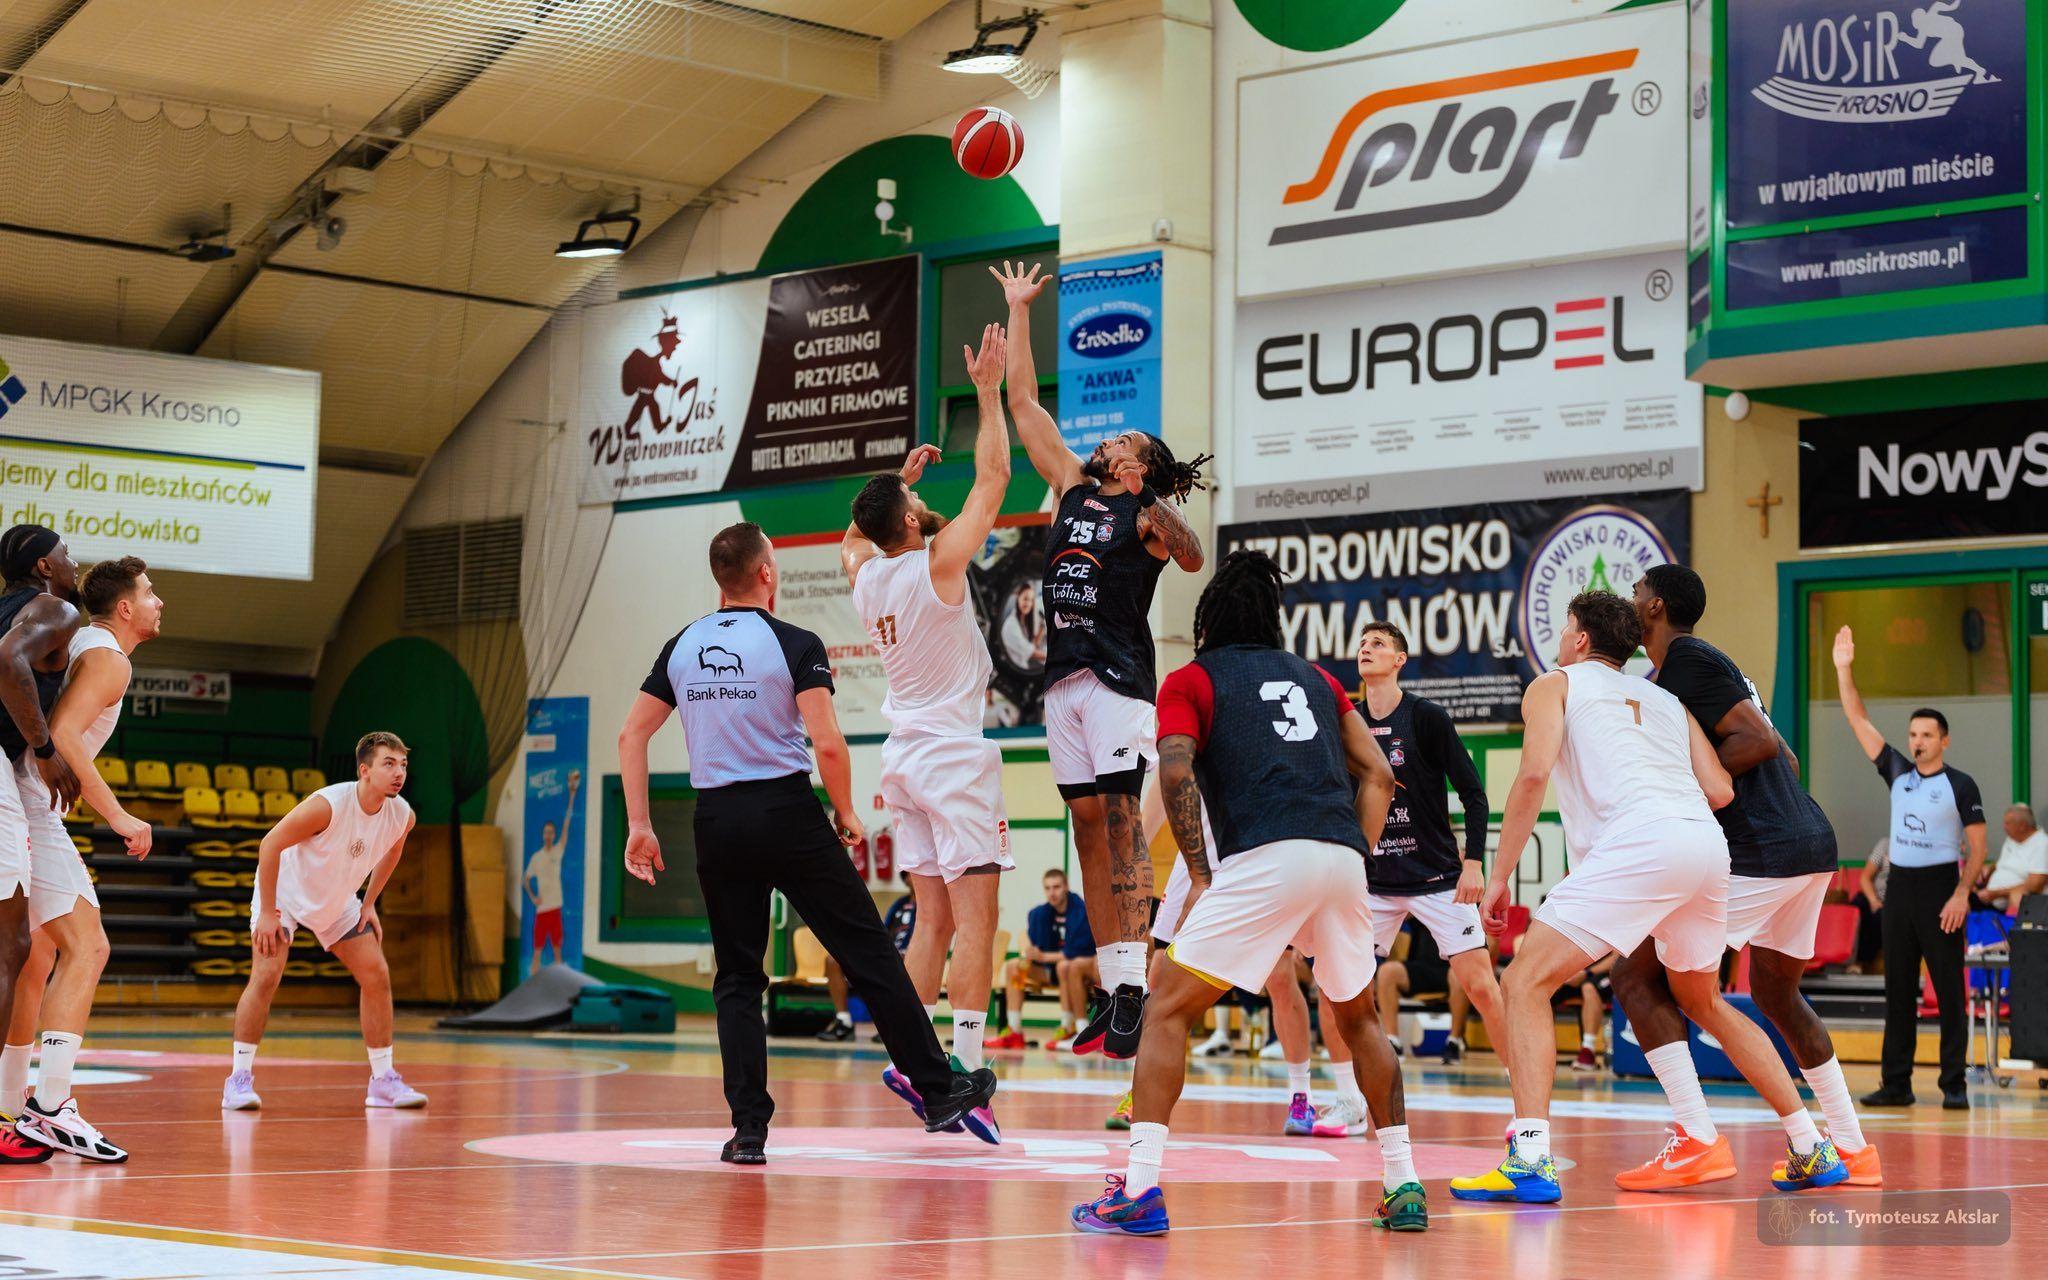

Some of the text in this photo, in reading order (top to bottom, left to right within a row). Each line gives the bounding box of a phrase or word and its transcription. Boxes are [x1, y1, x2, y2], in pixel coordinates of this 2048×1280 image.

[1776, 11, 1900, 83] MOSiR
[1837, 88, 1928, 115] KROSNO
[1758, 152, 1995, 205] w wyjątkowym mieście
[1781, 241, 1966, 284] www.mosirkrosno.pl
[806, 303, 870, 329] WESELA
[794, 330, 881, 361] CATERINGI
[1256, 296, 1655, 401] EUROPEL
[794, 361, 880, 390] PRZYJĘCIA
[40, 381, 241, 427] MPGK Krosno
[676, 377, 717, 433] Jaś
[767, 386, 909, 423] PIKNIKI FIRMOWE
[1081, 387, 1138, 405] KROSNO
[751, 447, 783, 471] HOTEL
[784, 438, 856, 468] RESTAURACJA
[65, 461, 107, 491] dla
[116, 472, 272, 506] mieszkańców
[1255, 457, 1674, 509] info@europel.pl www.europel.pl
[64, 508, 200, 544] środowiska
[1068, 520, 1096, 544] 25
[1230, 518, 1512, 584] DROWISKO
[1057, 563, 1091, 578] PGE
[1533, 525, 1653, 643] UZDROWISKO RYM
[1567, 563, 1634, 584] 18 76
[876, 615, 897, 645] 17
[1280, 588, 1524, 661] YMANÓW S.A.
[687, 687, 757, 702] Bank Pekao
[1258, 680, 1319, 742] 3
[1113, 748, 1129, 757] 4F
[1379, 836, 1416, 848] lubelskie
